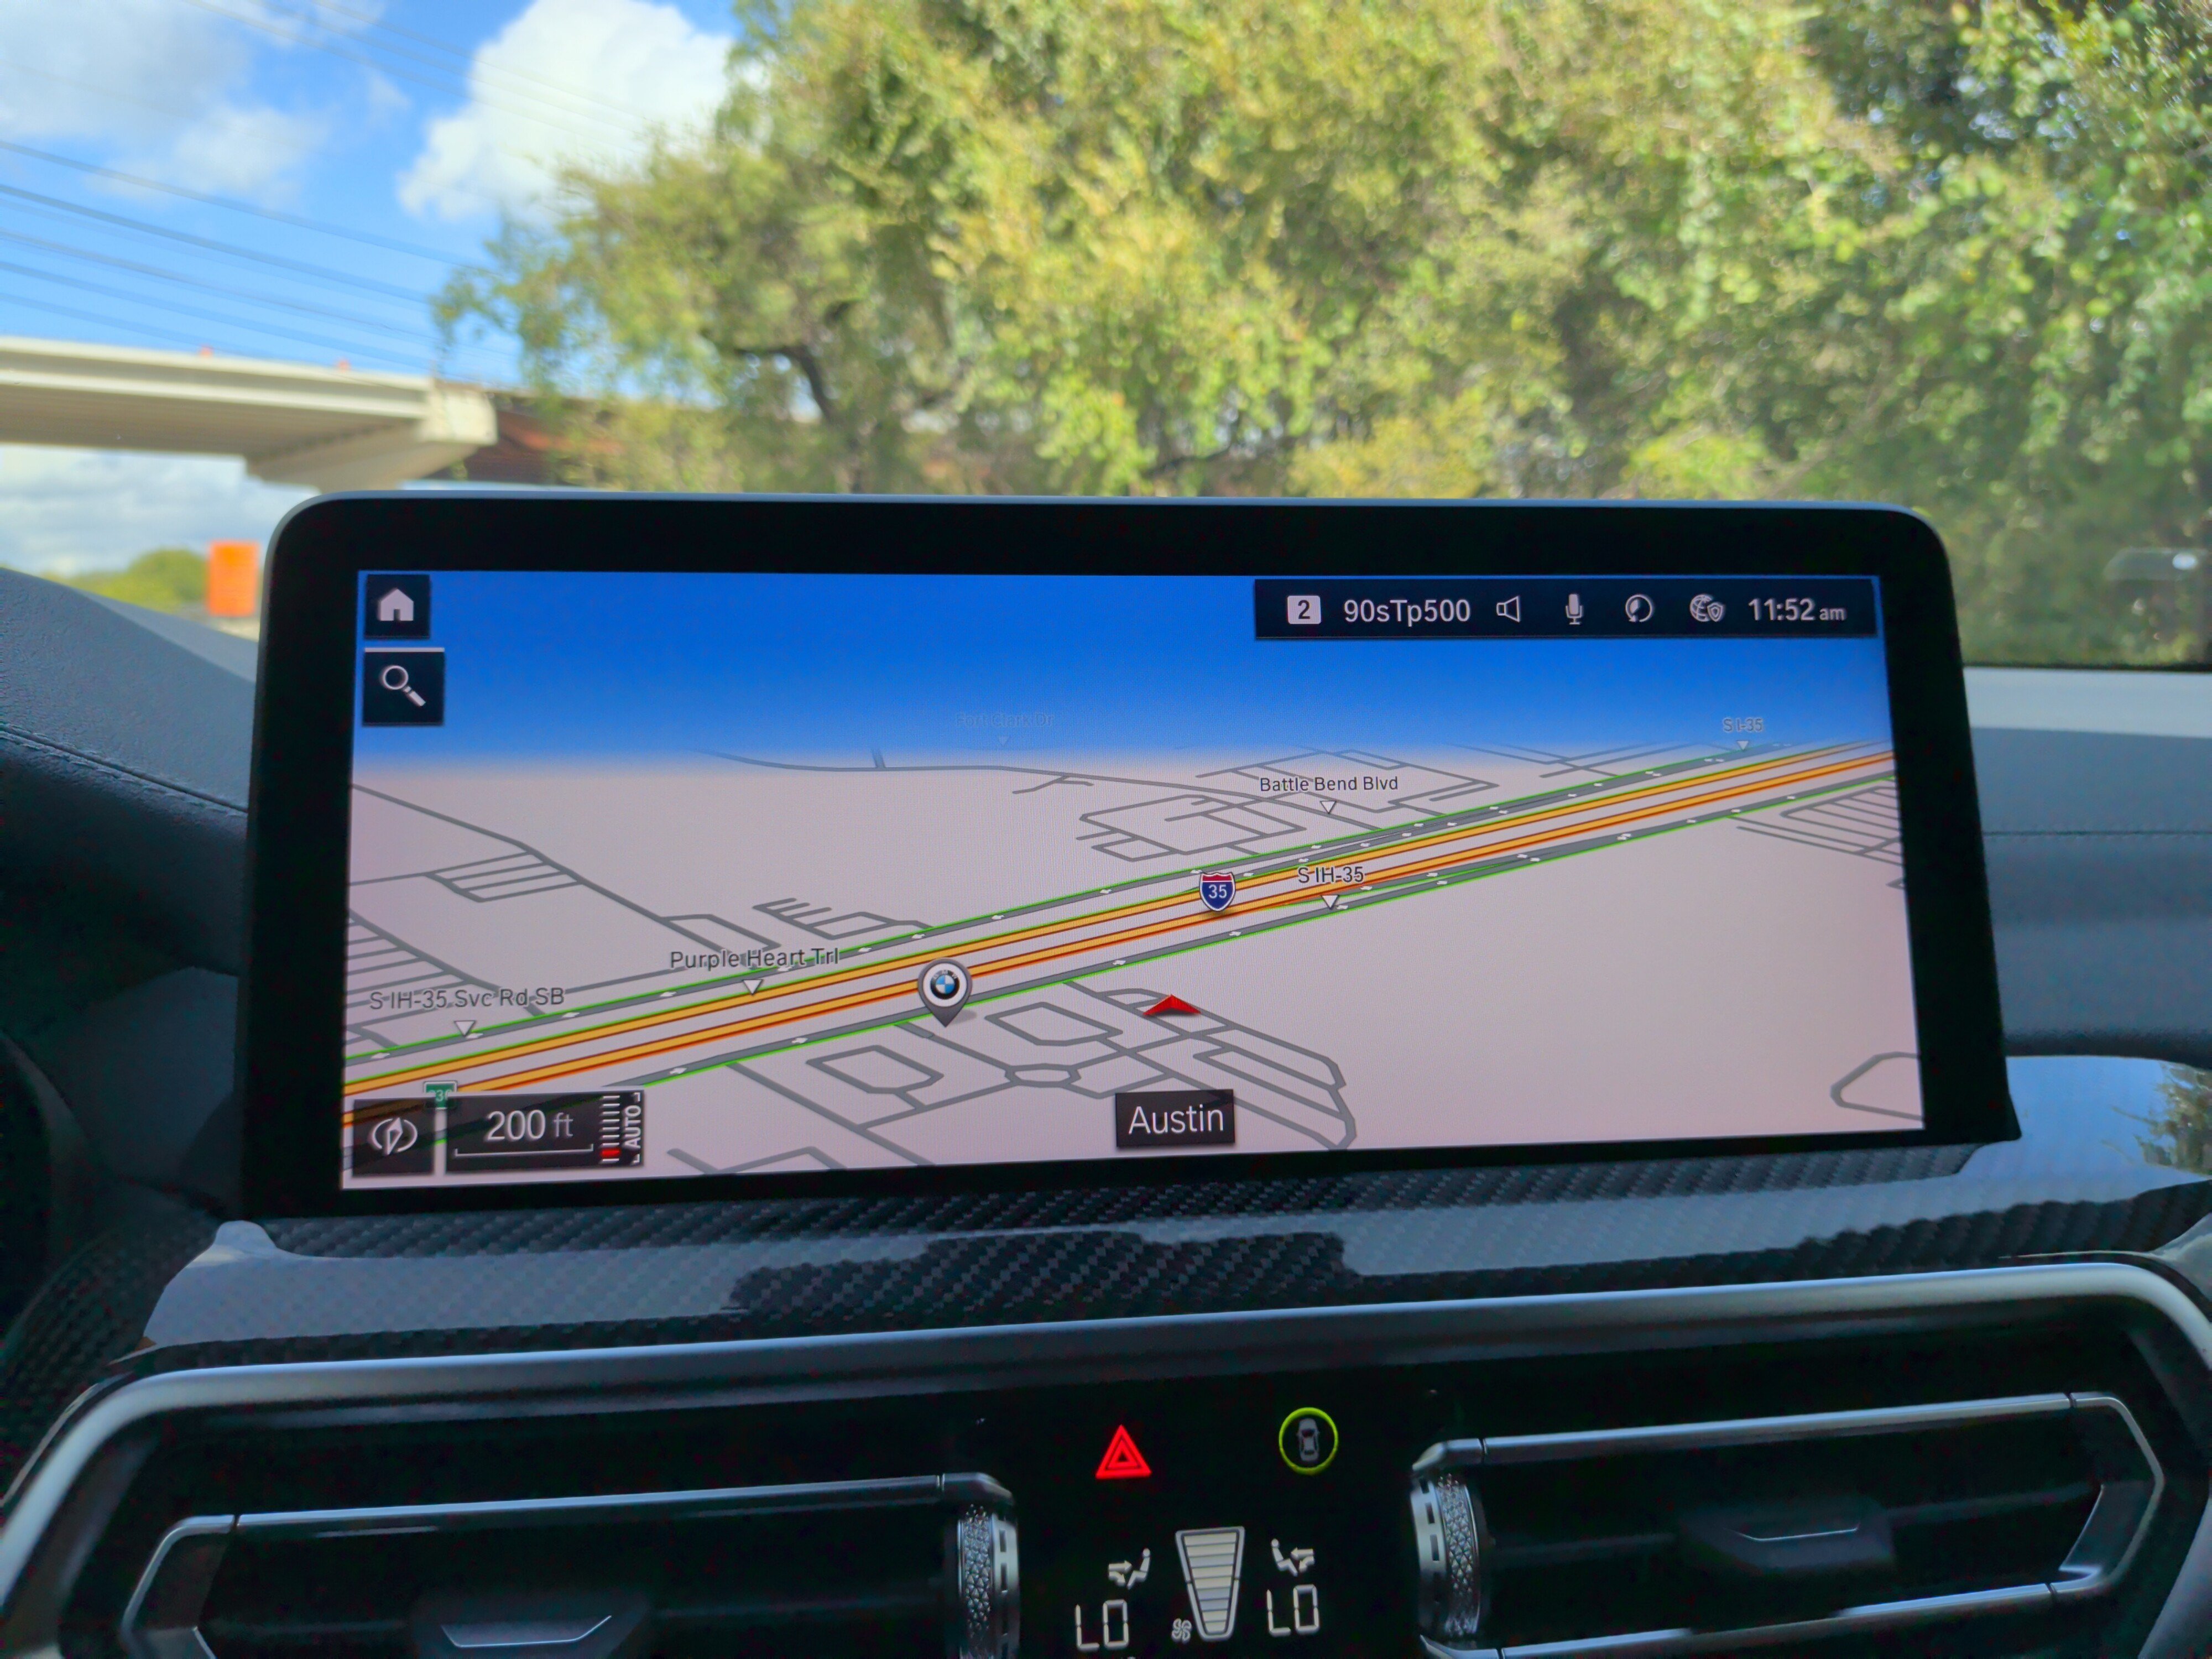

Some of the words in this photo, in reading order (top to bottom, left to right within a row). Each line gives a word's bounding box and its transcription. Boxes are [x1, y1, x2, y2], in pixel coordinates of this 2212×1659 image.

[1297, 599, 1311, 619] 2
[1344, 599, 1470, 627] 90sTp500
[1748, 598, 1815, 620] 11:52
[1819, 607, 1846, 620] am
[1723, 718, 1733, 732] S
[1736, 718, 1763, 732] I-35
[1260, 778, 1309, 791] Battle
[1314, 776, 1357, 791] Bend
[1363, 776, 1398, 790] Blvd
[1298, 867, 1310, 883] S
[1316, 866, 1364, 883] IH-35
[1208, 884, 1227, 899] 35
[670, 949, 740, 972] Purple
[747, 948, 805, 967] Heart
[811, 947, 839, 964] Trl
[369, 992, 383, 1009] S
[390, 989, 447, 1009] IH-35
[455, 989, 492, 1007] Svc
[500, 989, 528, 1006] Rd
[535, 987, 565, 1005] SB
[484, 1109, 545, 1141] 200
[553, 1112, 573, 1137] ft
[624, 1105, 641, 1149] AUTO
[1128, 1104, 1223, 1134] Austin
